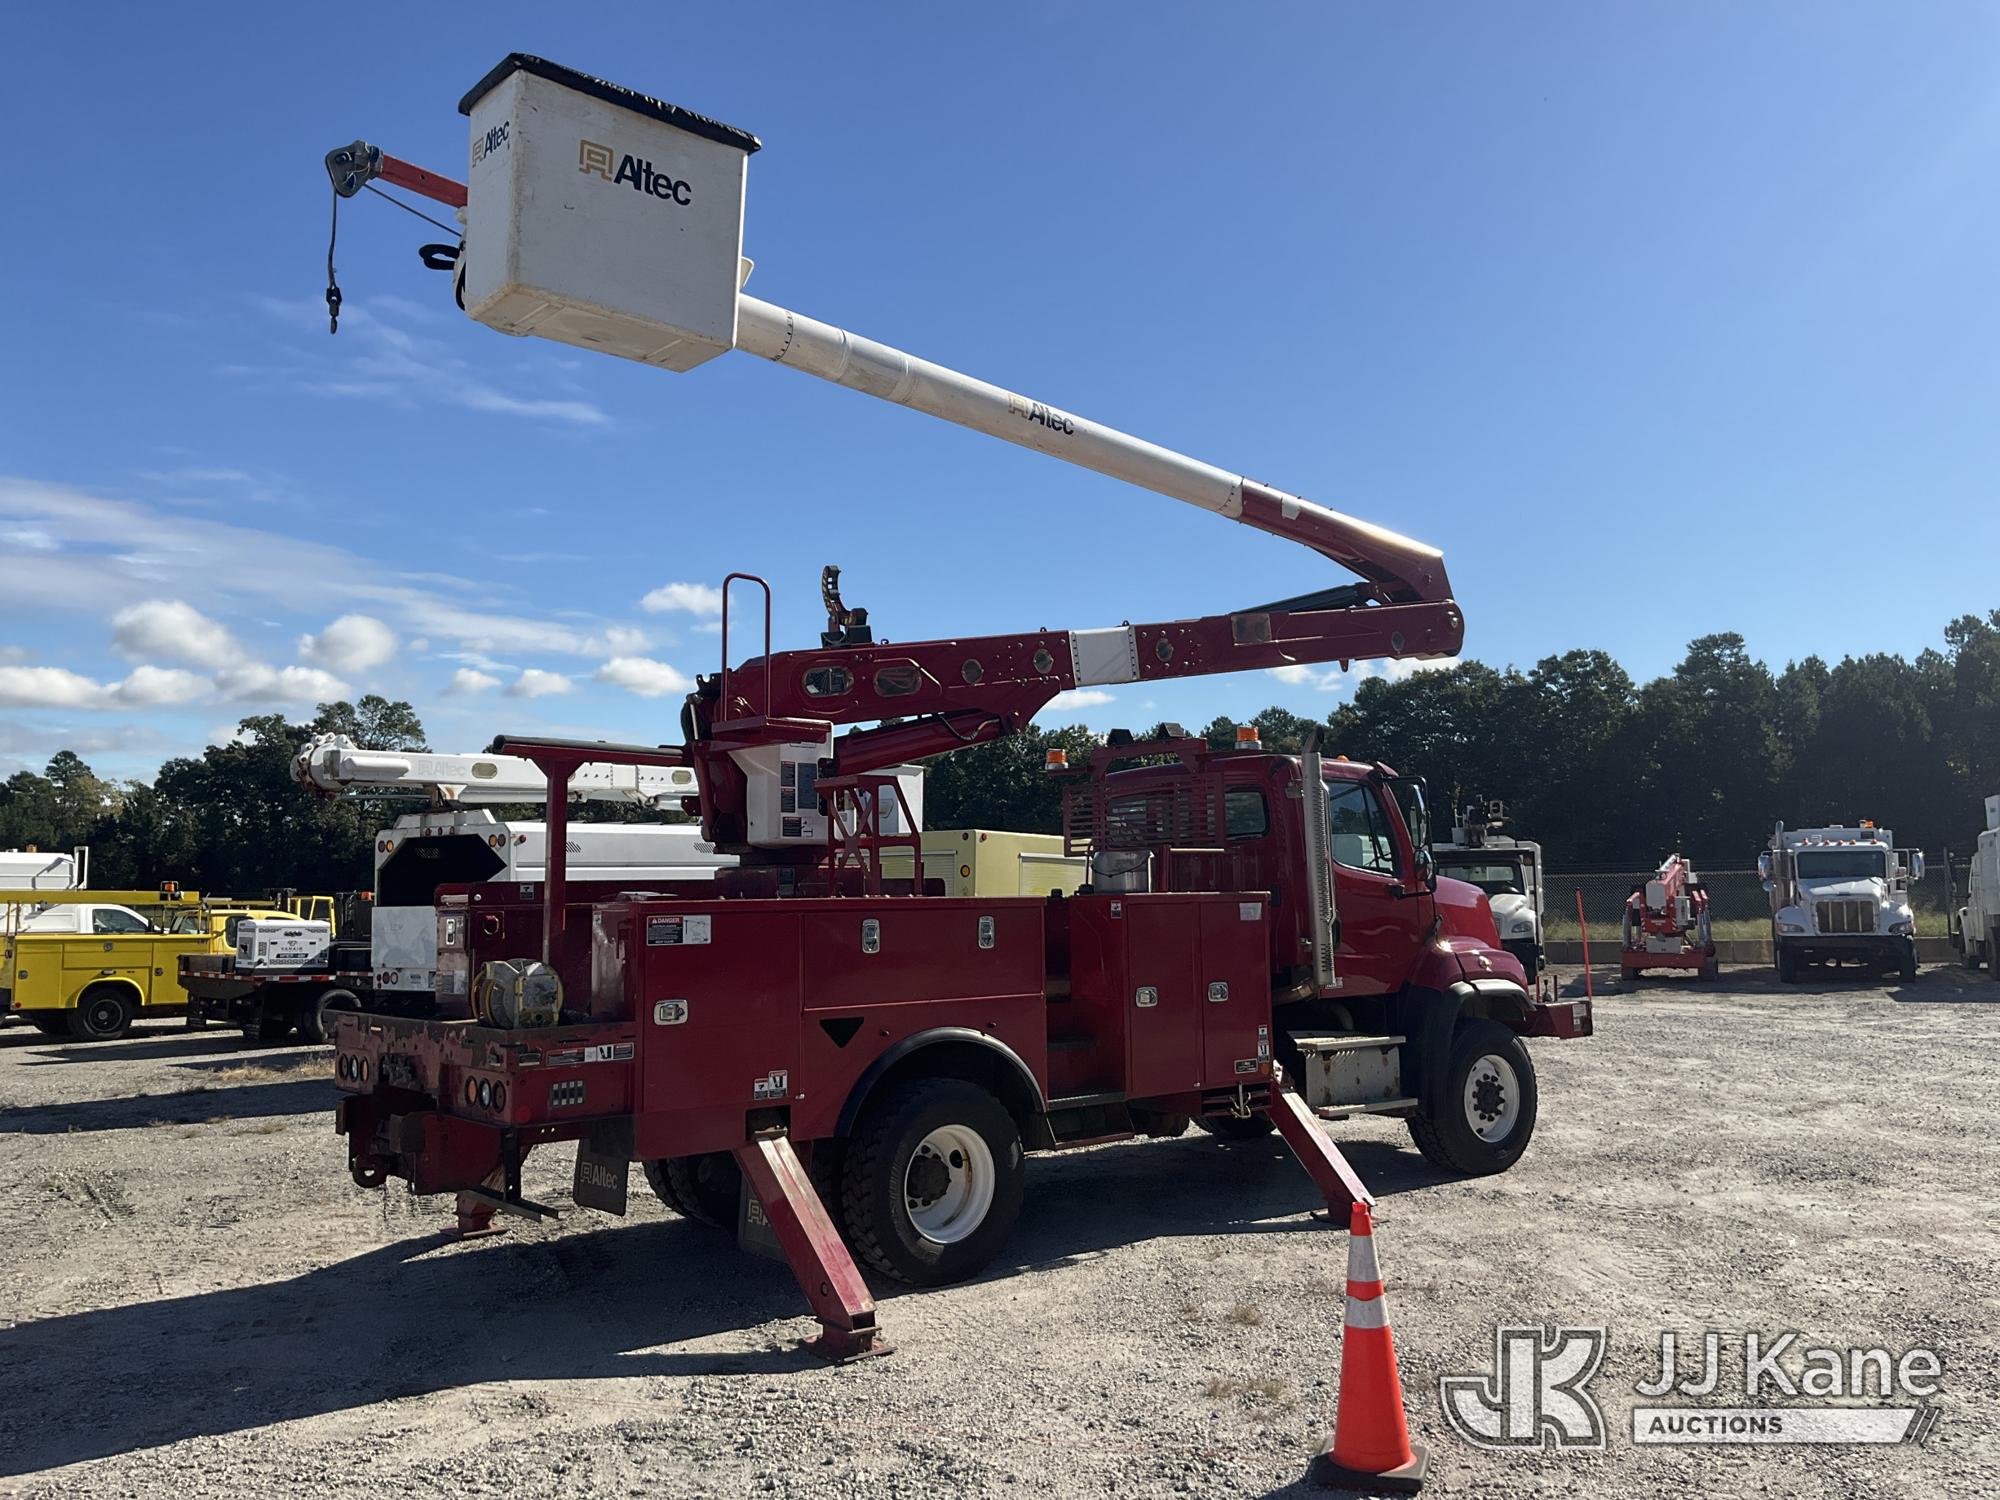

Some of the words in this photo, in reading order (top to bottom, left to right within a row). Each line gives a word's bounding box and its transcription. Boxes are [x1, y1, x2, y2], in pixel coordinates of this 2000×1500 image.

[484, 121, 509, 159] Altec
[613, 154, 692, 206] Altec
[1028, 403, 1074, 435] Altec
[433, 760, 466, 777] Altec
[592, 1165, 618, 1190] Altec
